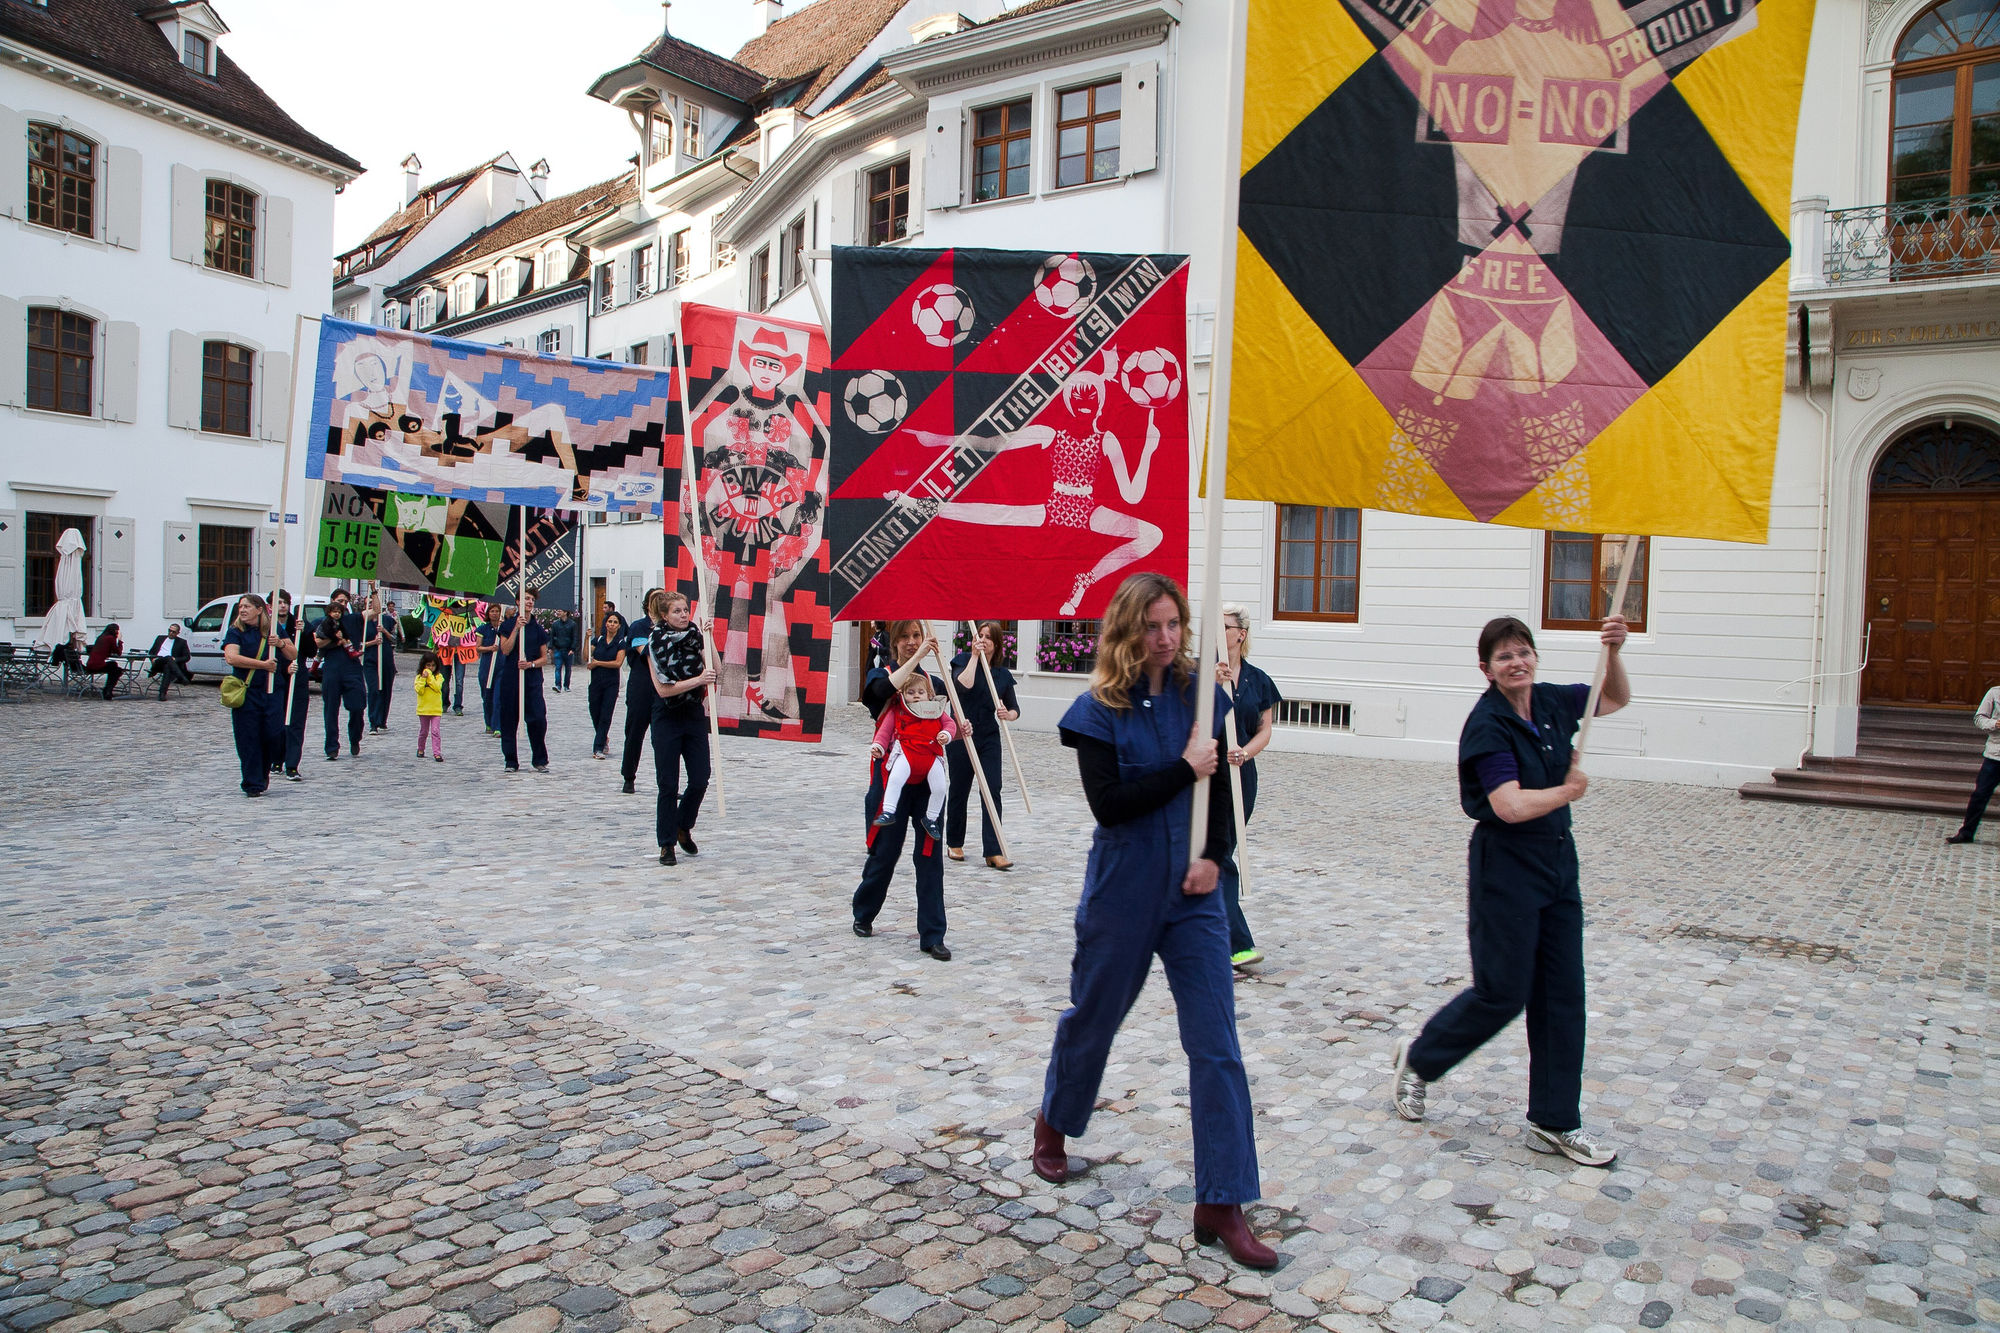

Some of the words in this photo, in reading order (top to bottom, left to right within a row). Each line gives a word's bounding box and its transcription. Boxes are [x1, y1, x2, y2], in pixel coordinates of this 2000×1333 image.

[1608, 1, 1715, 73] PROUD
[1456, 255, 1547, 294] FREE
[1847, 329, 1882, 345] ZUR
[1906, 322, 1981, 342] JOHANN
[927, 448, 976, 498] LET
[992, 382, 1044, 431] THE
[1045, 312, 1111, 379] BOYS
[1112, 262, 1160, 309] WIN
[328, 492, 385, 520] NOT
[326, 521, 381, 548] THE
[323, 546, 377, 571] DOG
[506, 560, 541, 590] ENMY
[545, 543, 560, 560] OF
[435, 618, 449, 635] NO
[450, 620, 465, 634] NO
[460, 648, 475, 661] NO
